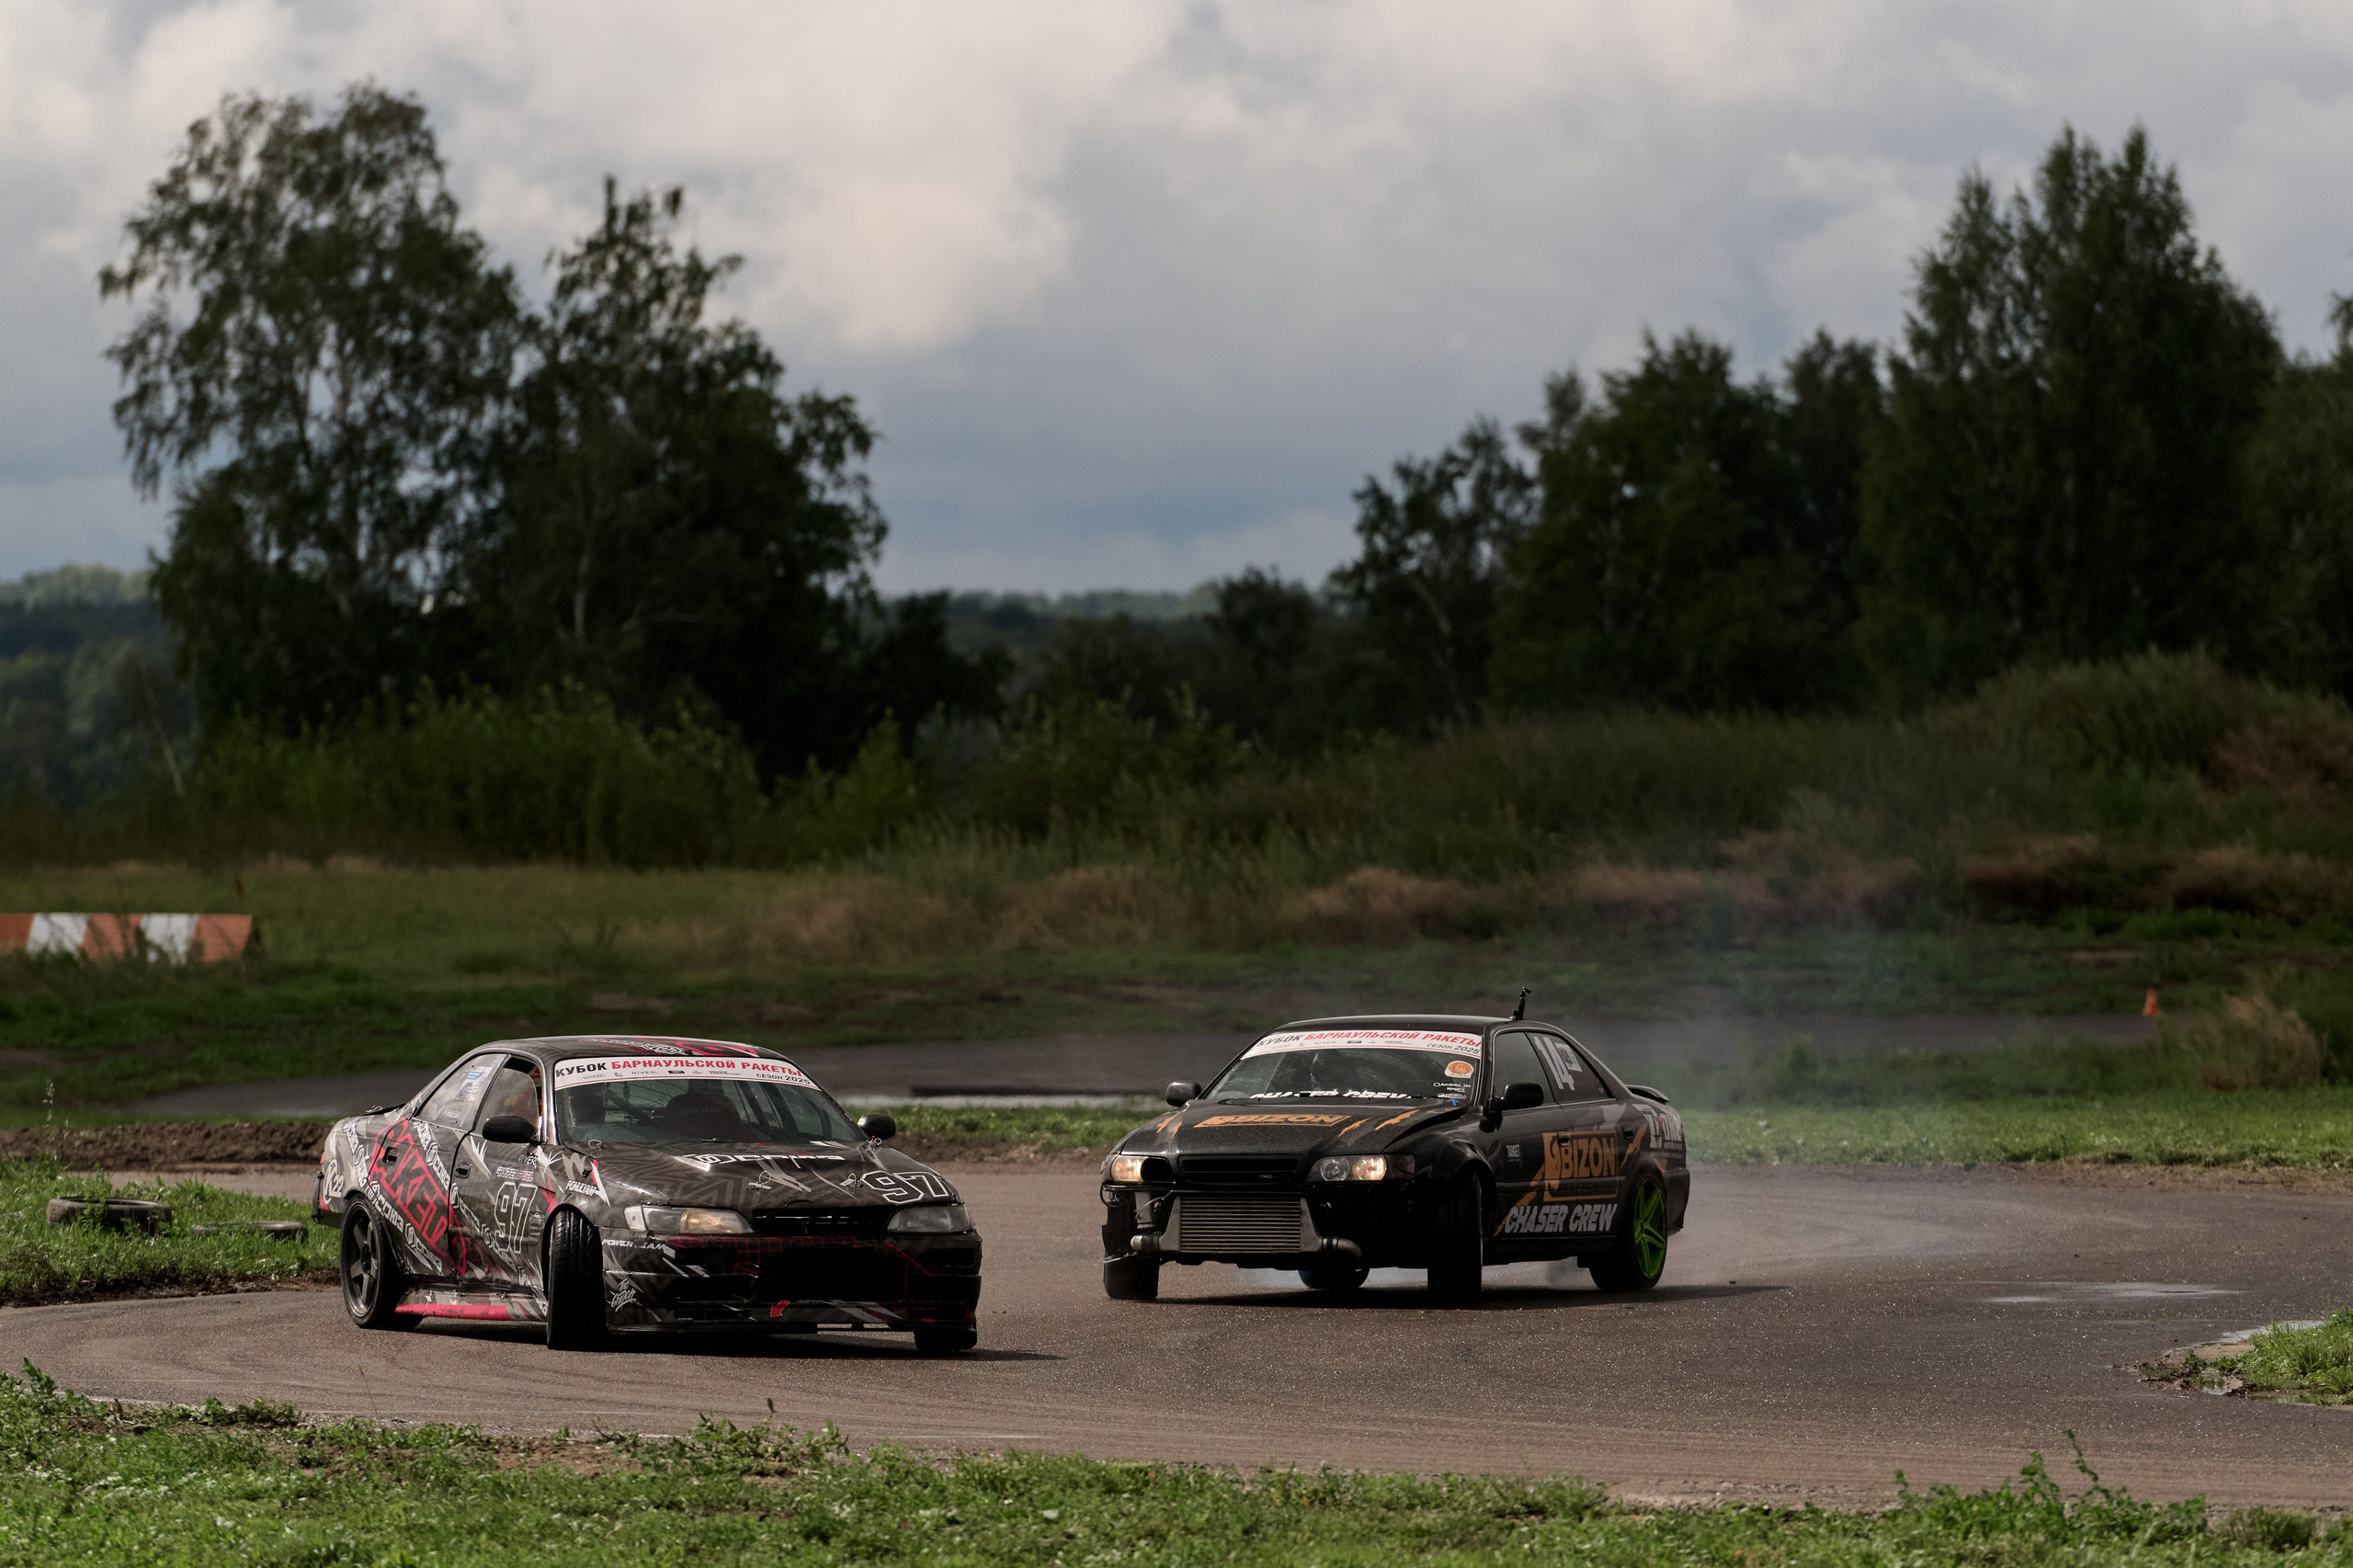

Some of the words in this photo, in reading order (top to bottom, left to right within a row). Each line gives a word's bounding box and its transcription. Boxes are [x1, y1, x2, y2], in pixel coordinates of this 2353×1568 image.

[1256, 1034, 1303, 1047] КУБОК
[1305, 1031, 1420, 1040] БАРНАУЛЬСКОЙ
[1422, 1034, 1482, 1047] РАКЕТЫ
[1454, 1045, 1481, 1054] 2025
[555, 1062, 608, 1077] КУБОК
[611, 1059, 735, 1069] БАРНАУЛЬСКОЙ
[741, 1062, 802, 1076] РАКЕТЫ
[1533, 1036, 1575, 1091] 14
[756, 1073, 783, 1081] СЕЗОН
[785, 1075, 811, 1085] 2025
[1230, 1113, 1347, 1123] BIZON
[1506, 1144, 1522, 1159] TARGET
[1560, 1136, 1617, 1179] BIZON
[860, 1170, 951, 1205] 97
[494, 1180, 539, 1255] 97
[1505, 1204, 1569, 1233] CHASER
[1569, 1203, 1619, 1233] CREW
